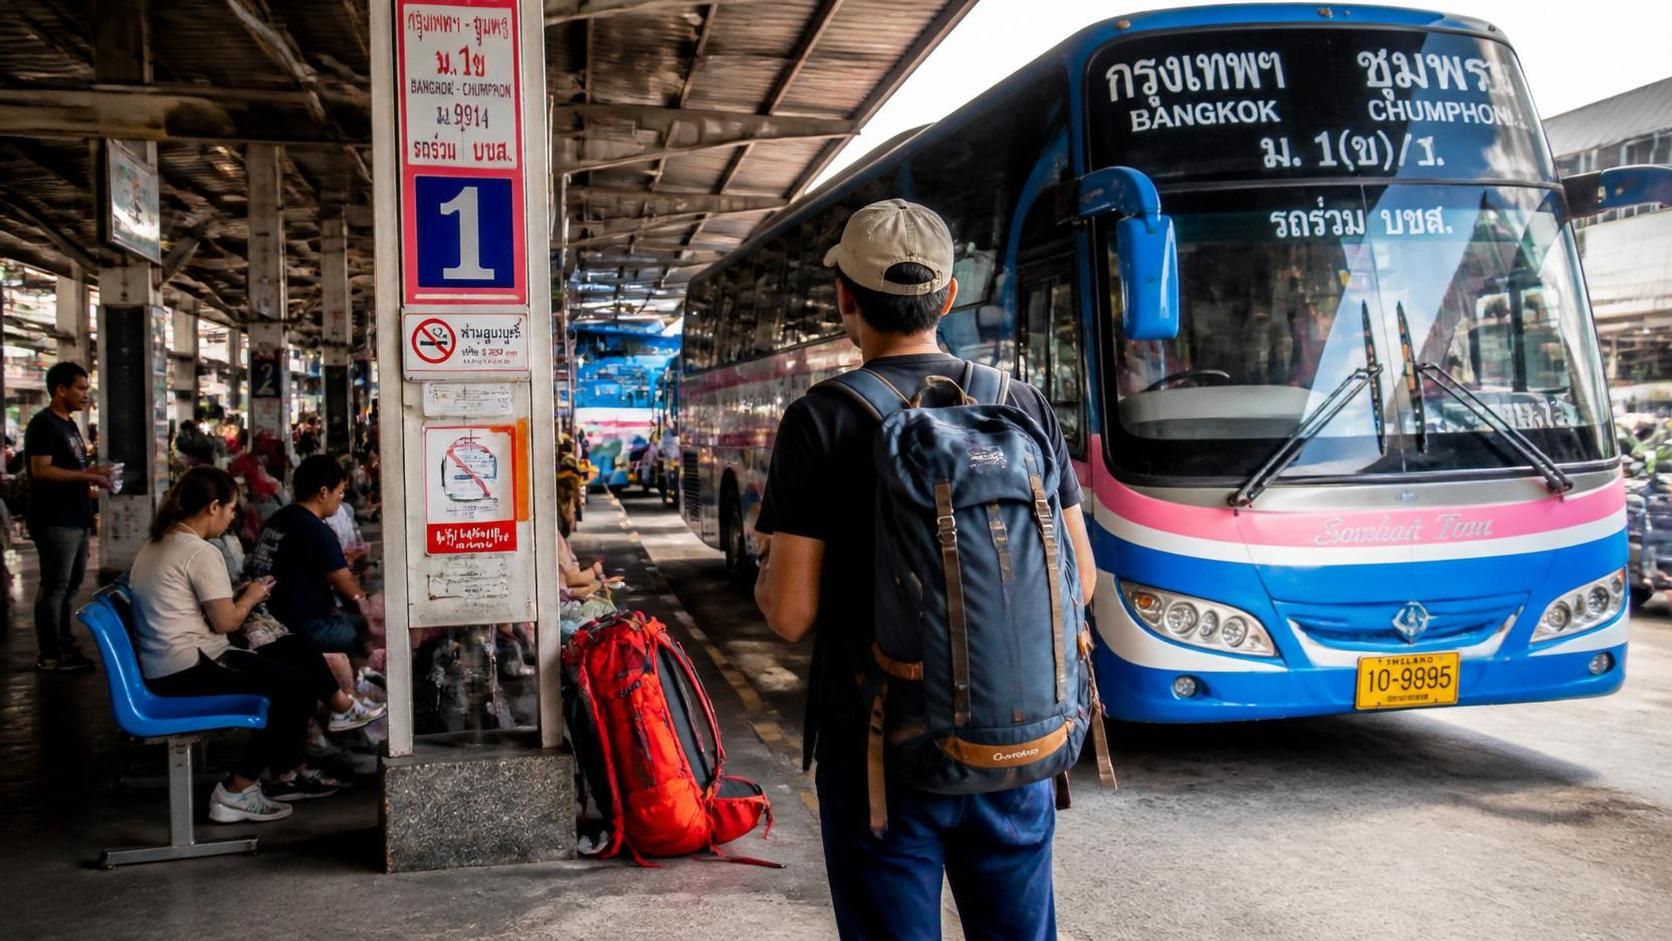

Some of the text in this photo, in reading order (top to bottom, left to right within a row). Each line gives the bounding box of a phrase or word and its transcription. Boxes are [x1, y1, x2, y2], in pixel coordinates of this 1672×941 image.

[1105, 48, 1490, 108] กรุงเทพฯ ชุมพร
[1129, 99, 1514, 133] BANGKOK CHUMPHON
[1260, 137, 1302, 168] ม.
[440, 186, 495, 280] 1
[1270, 196, 1365, 238] รถร่วม
[256, 362, 276, 396] 2
[1368, 665, 1452, 692] 10-9895
